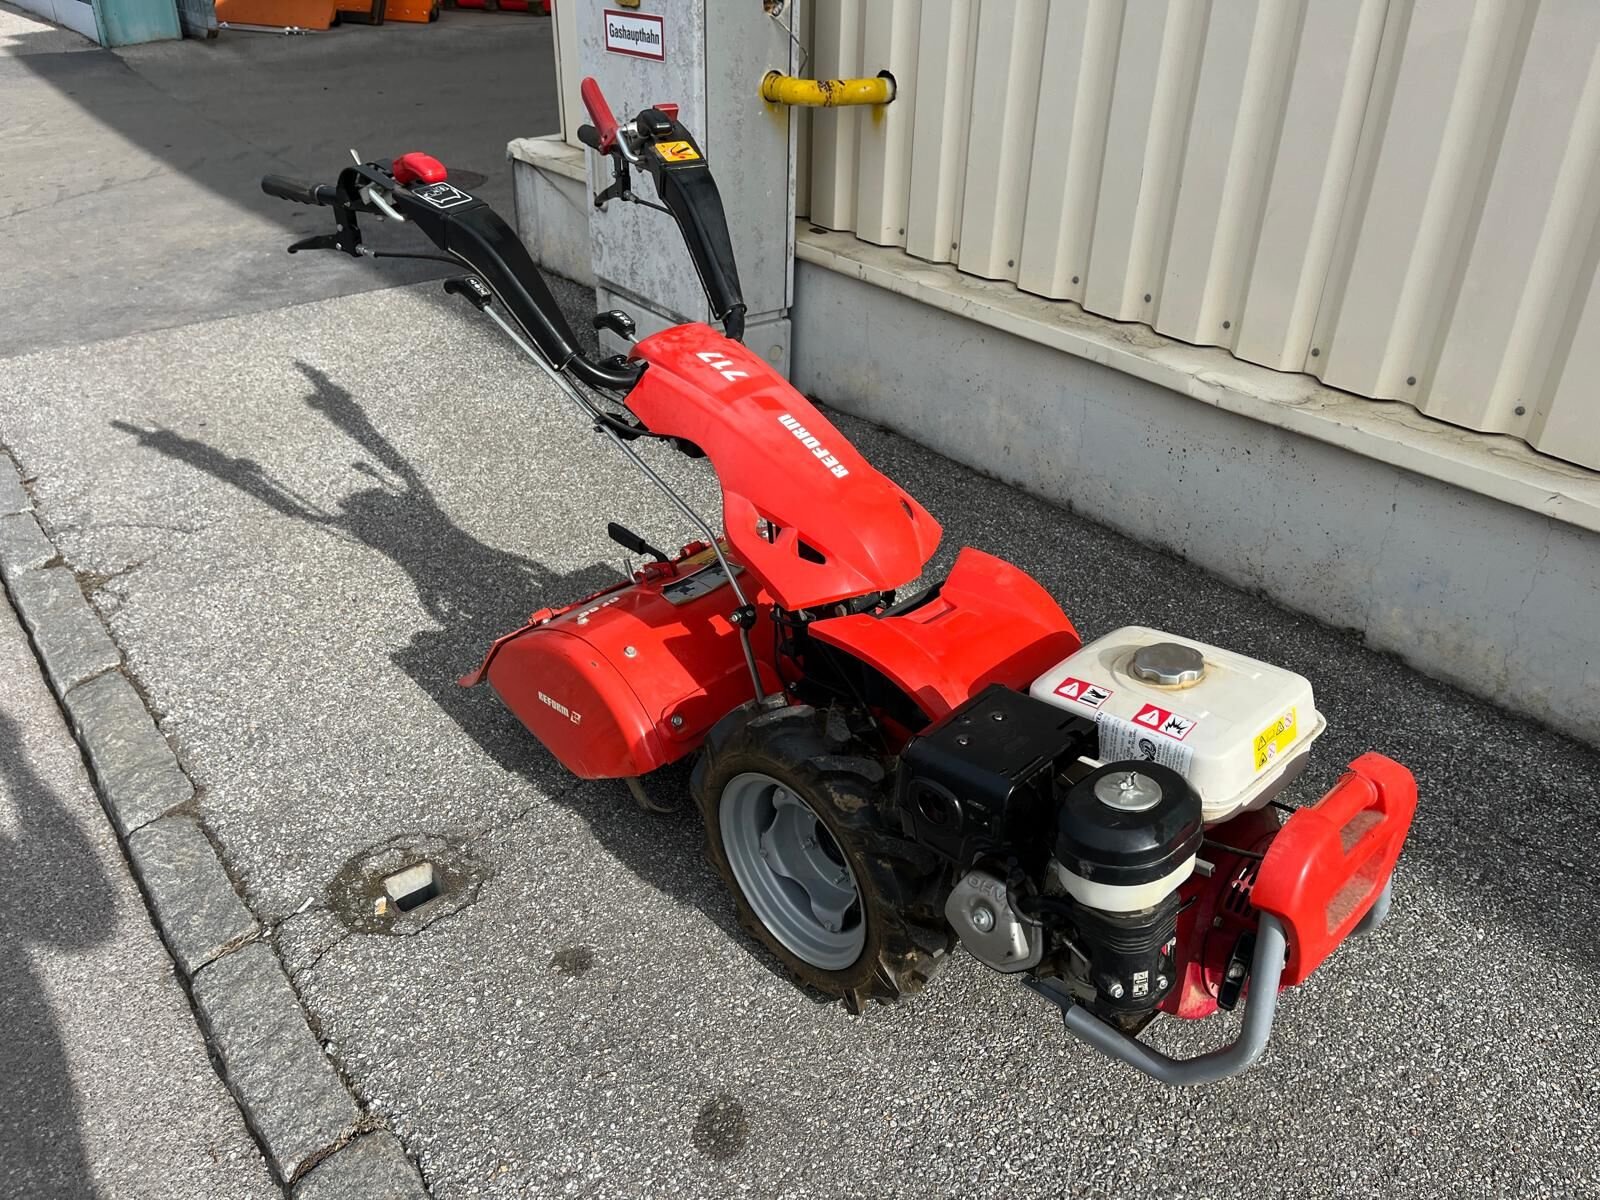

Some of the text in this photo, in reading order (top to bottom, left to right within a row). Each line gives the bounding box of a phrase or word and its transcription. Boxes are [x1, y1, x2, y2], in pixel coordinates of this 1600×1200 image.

[609, 23, 659, 46] Gashaupthahn
[696, 351, 748, 382] 717
[777, 413, 849, 479] REFORM
[538, 691, 569, 717] REFORM
